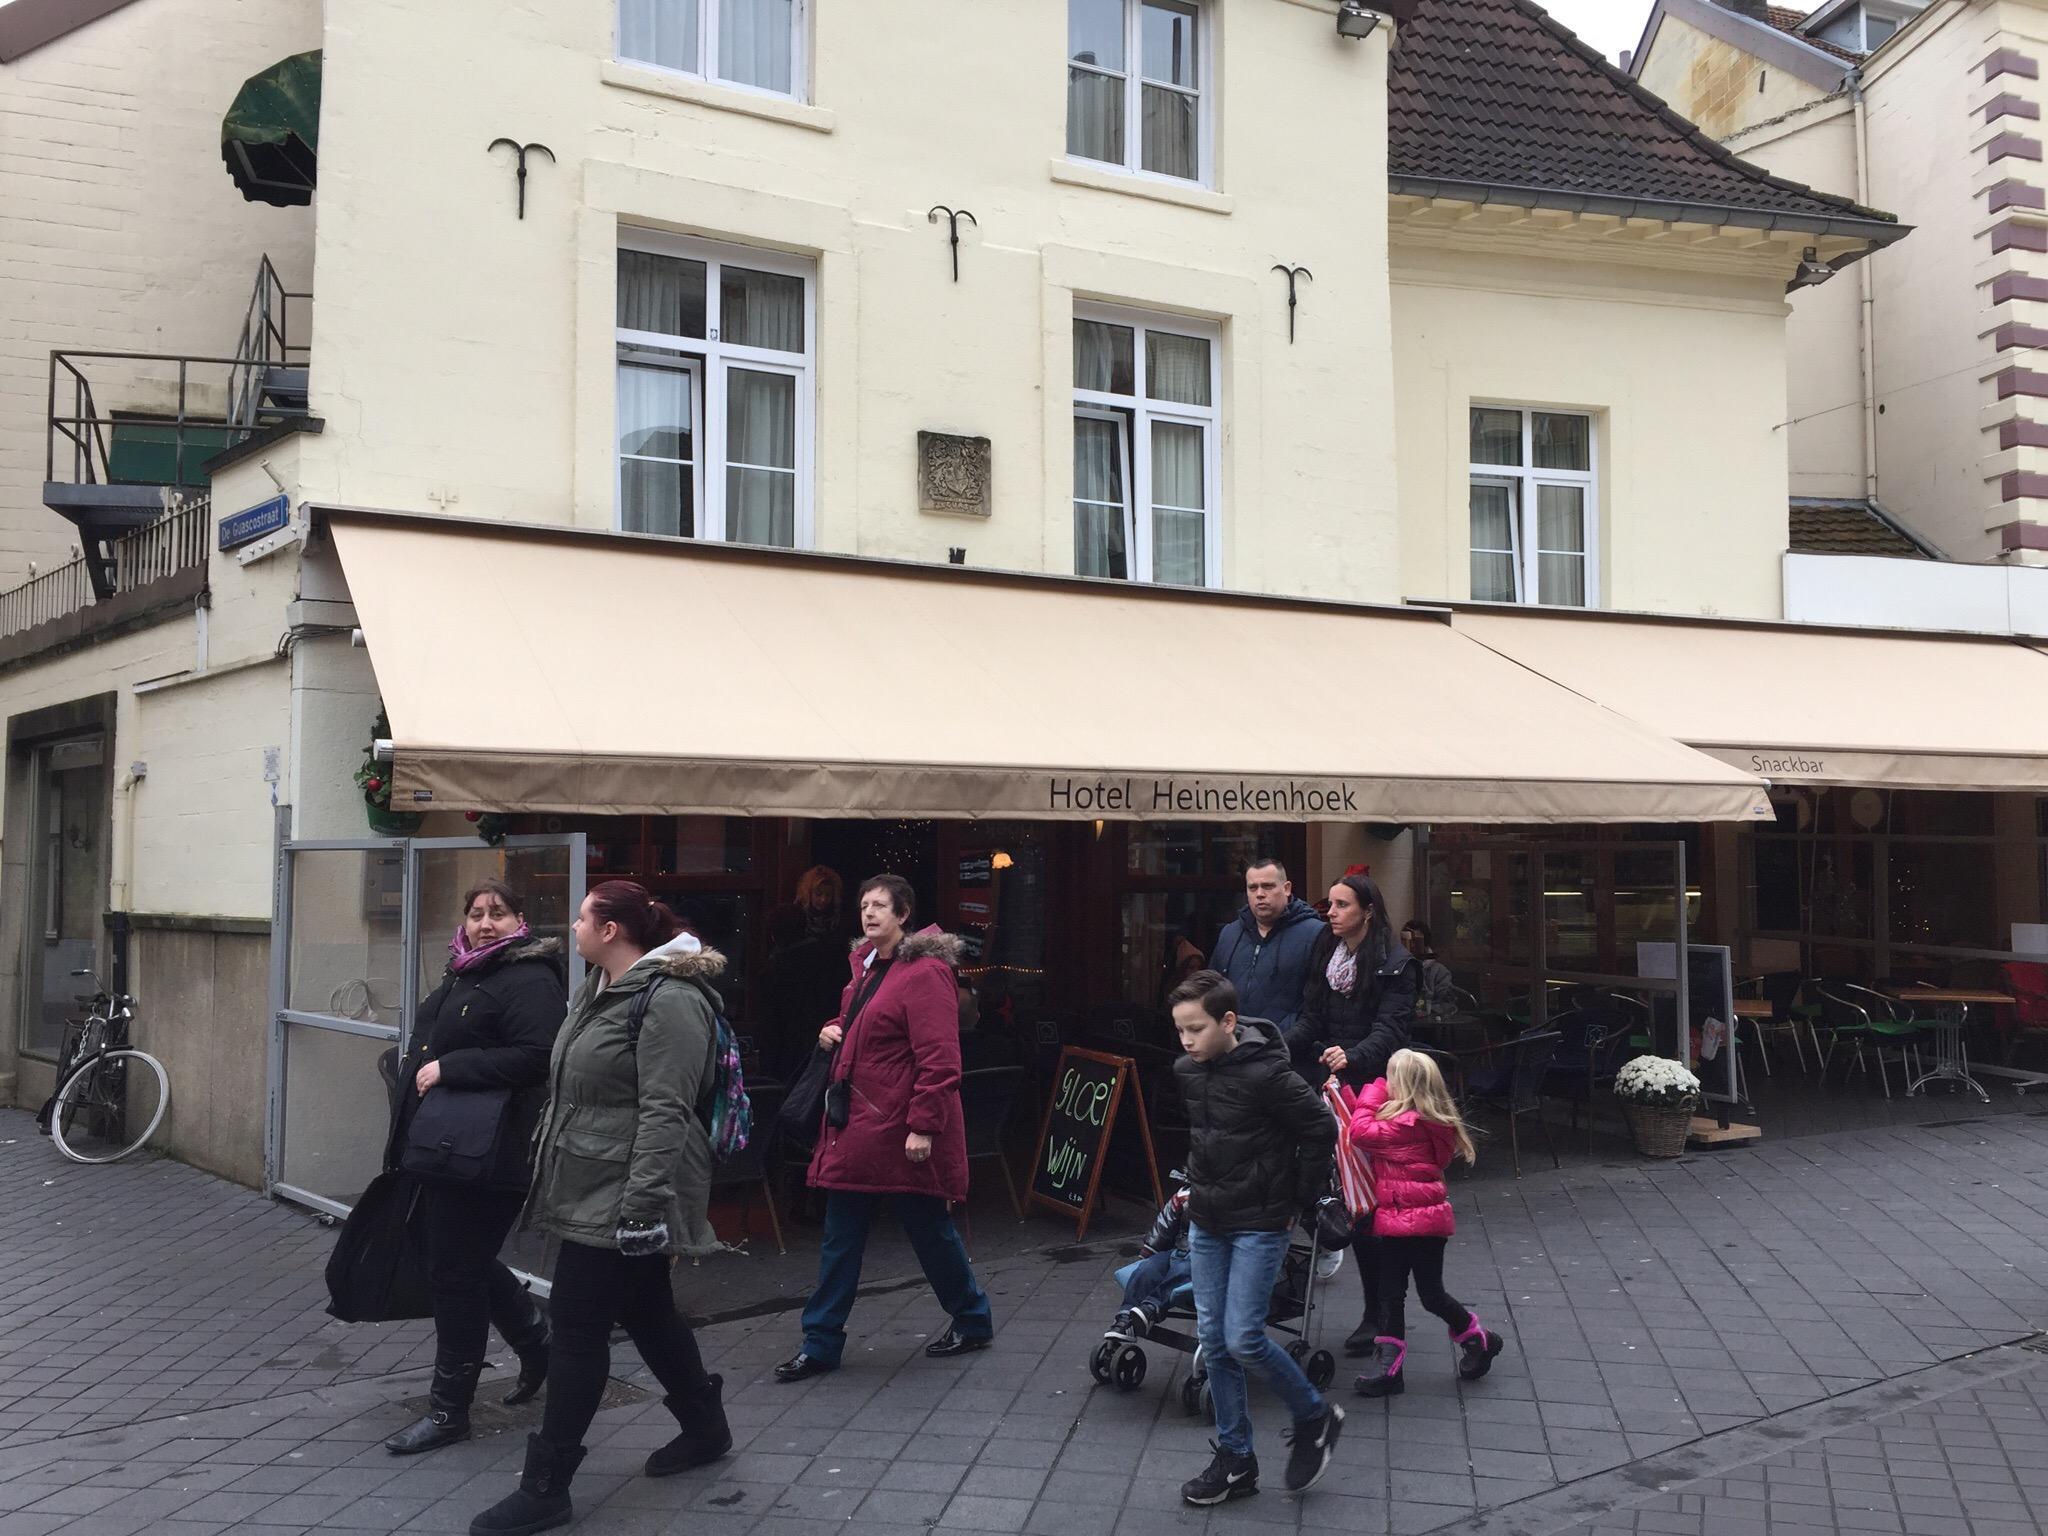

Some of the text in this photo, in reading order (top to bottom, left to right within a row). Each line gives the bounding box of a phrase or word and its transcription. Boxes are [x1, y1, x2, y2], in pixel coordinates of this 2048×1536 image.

[221, 506, 279, 541] De Guascostraat
[1751, 755, 1824, 774] Snackbar
[1050, 778, 1358, 811] Hotel Heinekenhoek
